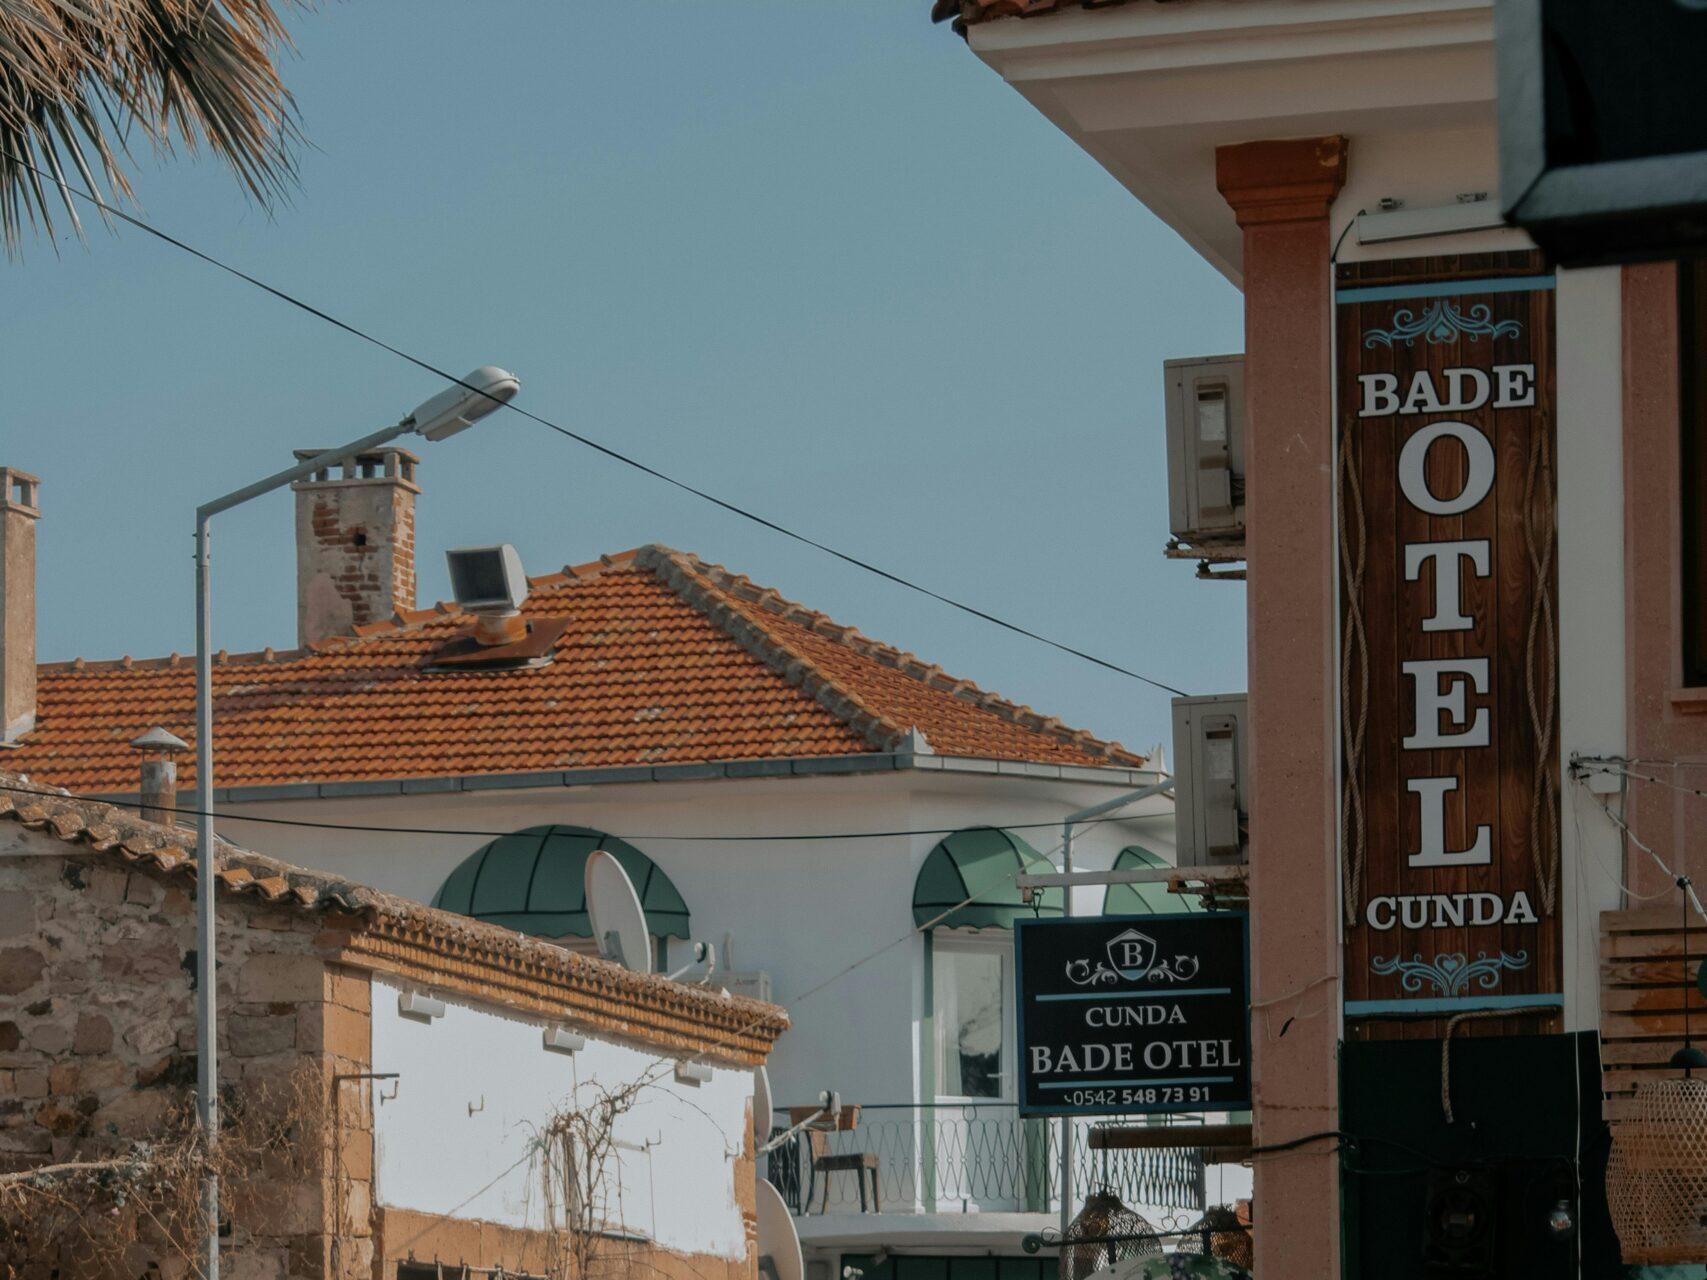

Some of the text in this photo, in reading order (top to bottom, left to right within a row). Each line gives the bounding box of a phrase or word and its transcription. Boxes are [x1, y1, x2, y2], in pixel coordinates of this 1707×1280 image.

[1358, 363, 1536, 419] BADE
[1398, 420, 1497, 868] OTEL
[1365, 889, 1539, 932] CUNDA
[1121, 942, 1143, 967] B
[1085, 1004, 1187, 1027] CUNDA
[1030, 1039, 1241, 1074] BADE OTEL
[1073, 1086, 1210, 1106] 0542 548 73 91
